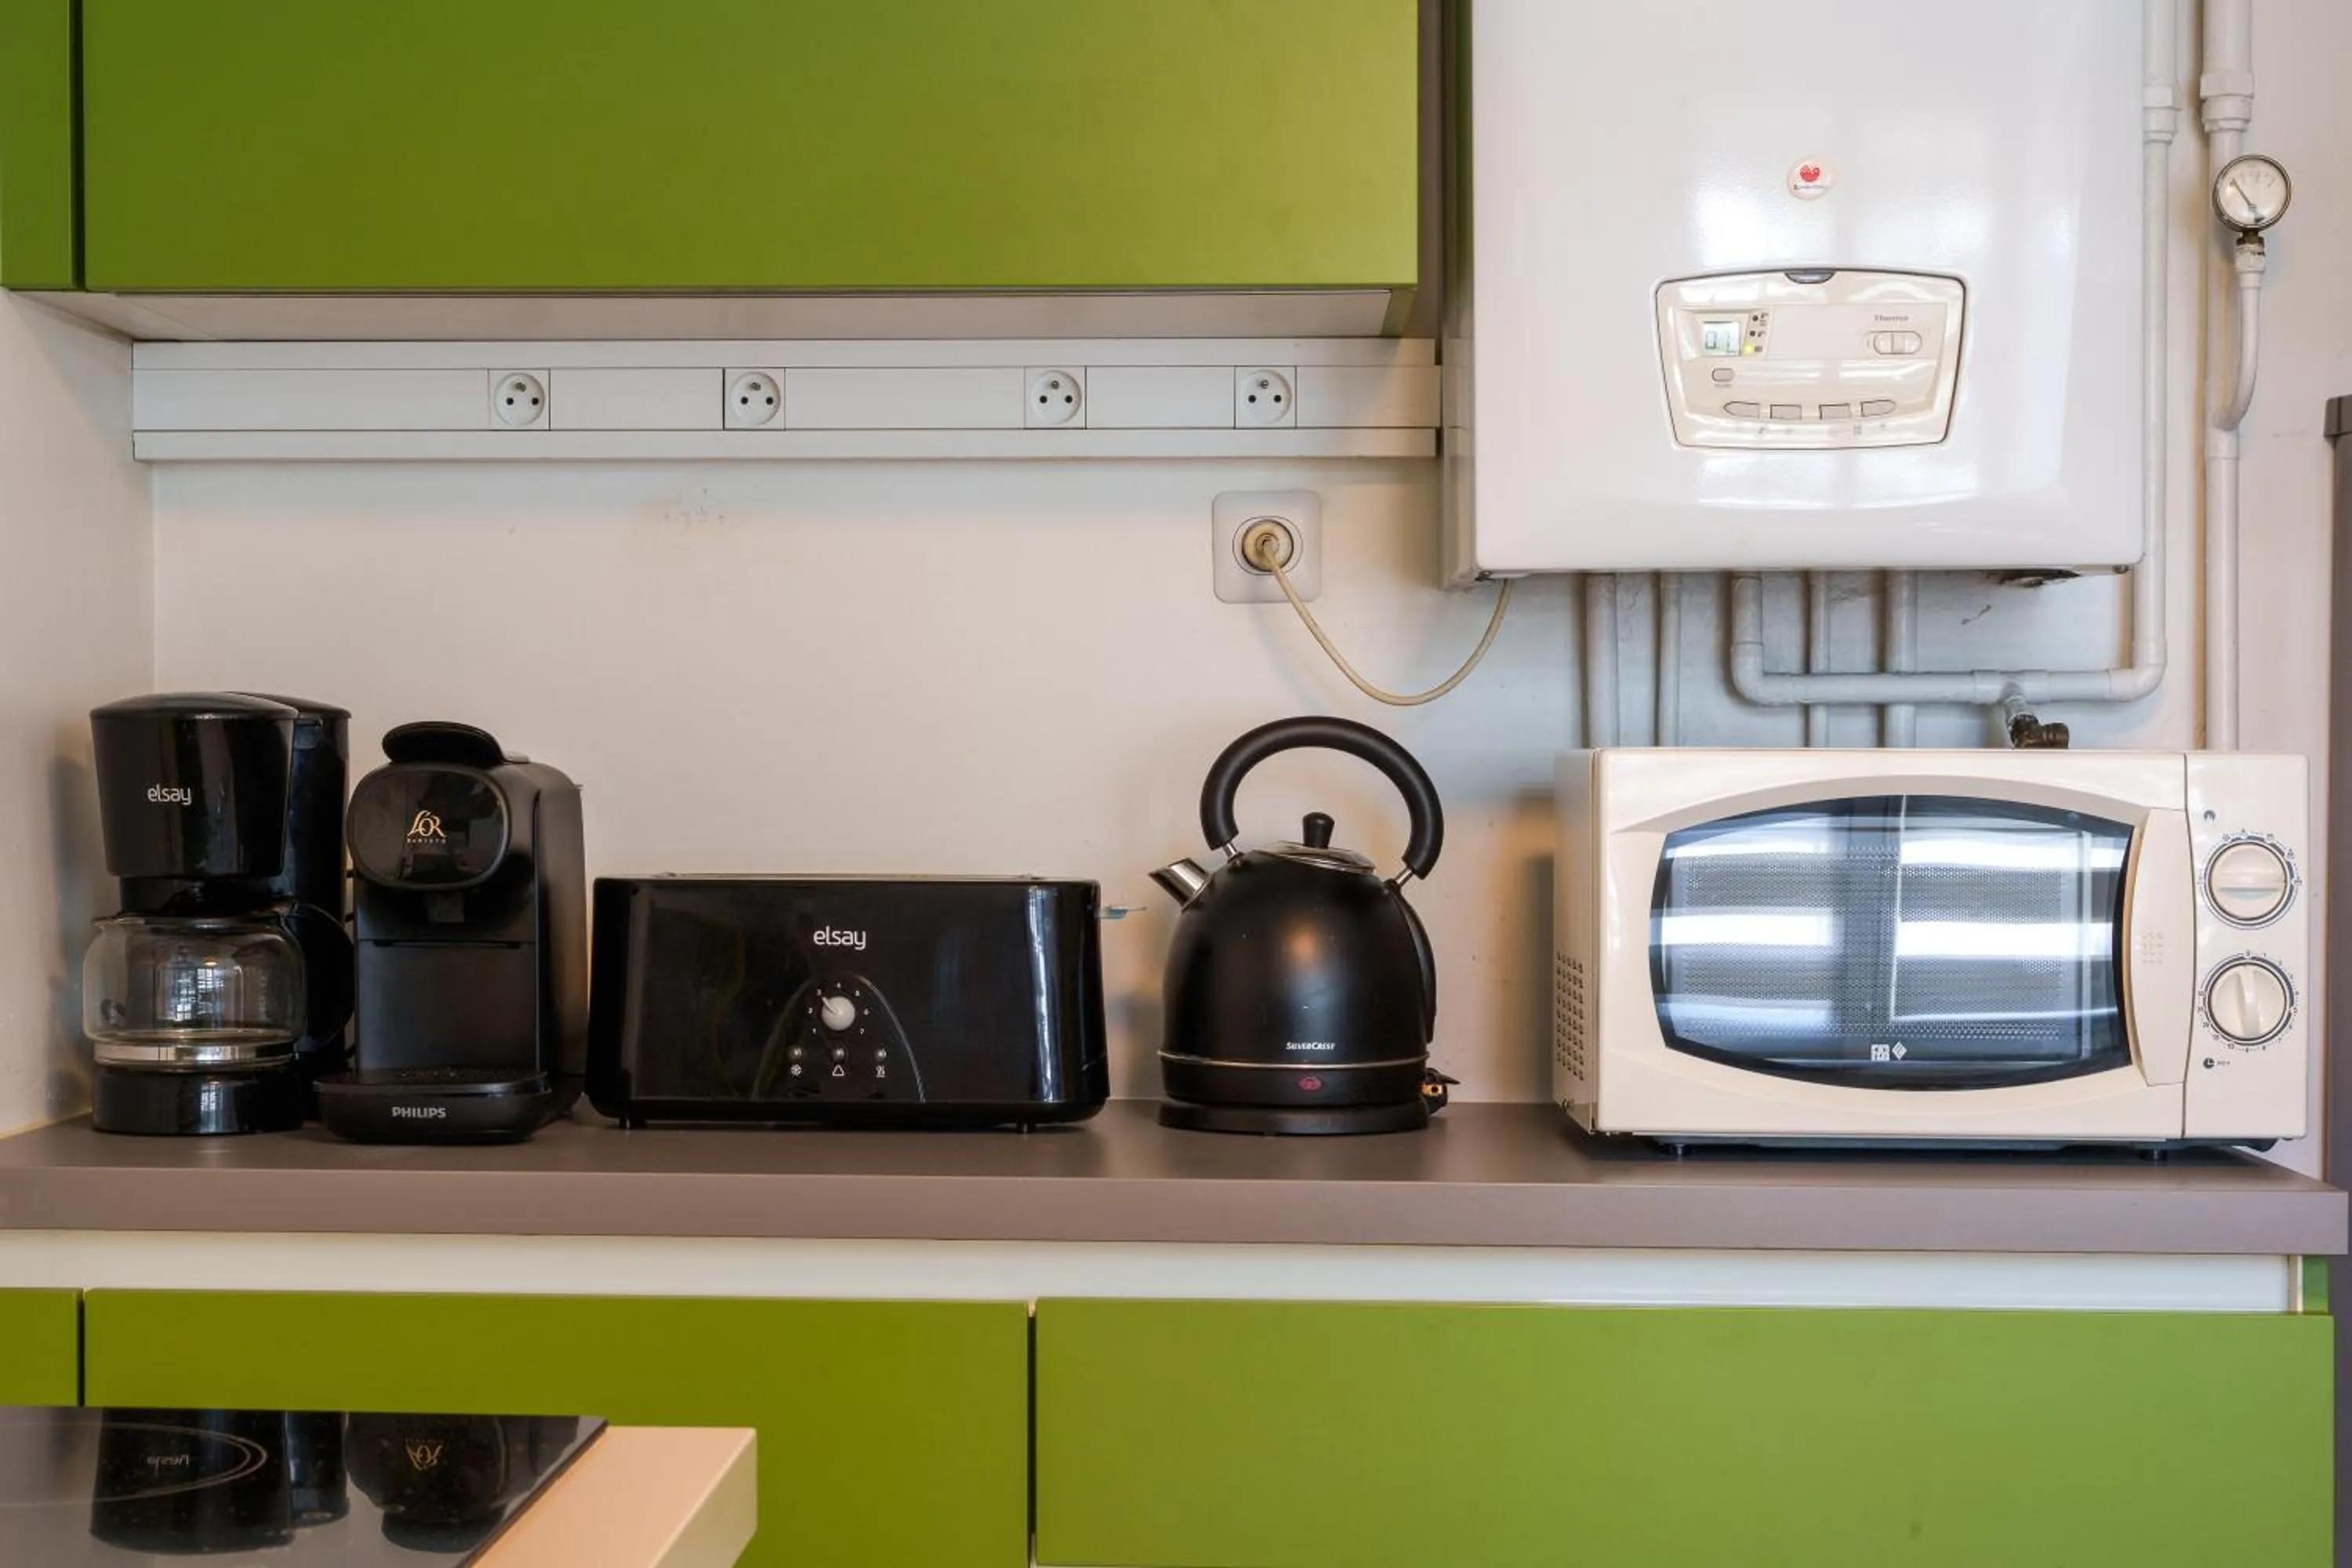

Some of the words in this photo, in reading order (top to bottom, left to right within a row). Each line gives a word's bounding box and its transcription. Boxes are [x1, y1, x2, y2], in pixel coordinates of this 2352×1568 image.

[147, 783, 191, 805] elsay
[813, 925, 866, 950] elsay
[391, 1106, 447, 1119] PHILIPS
